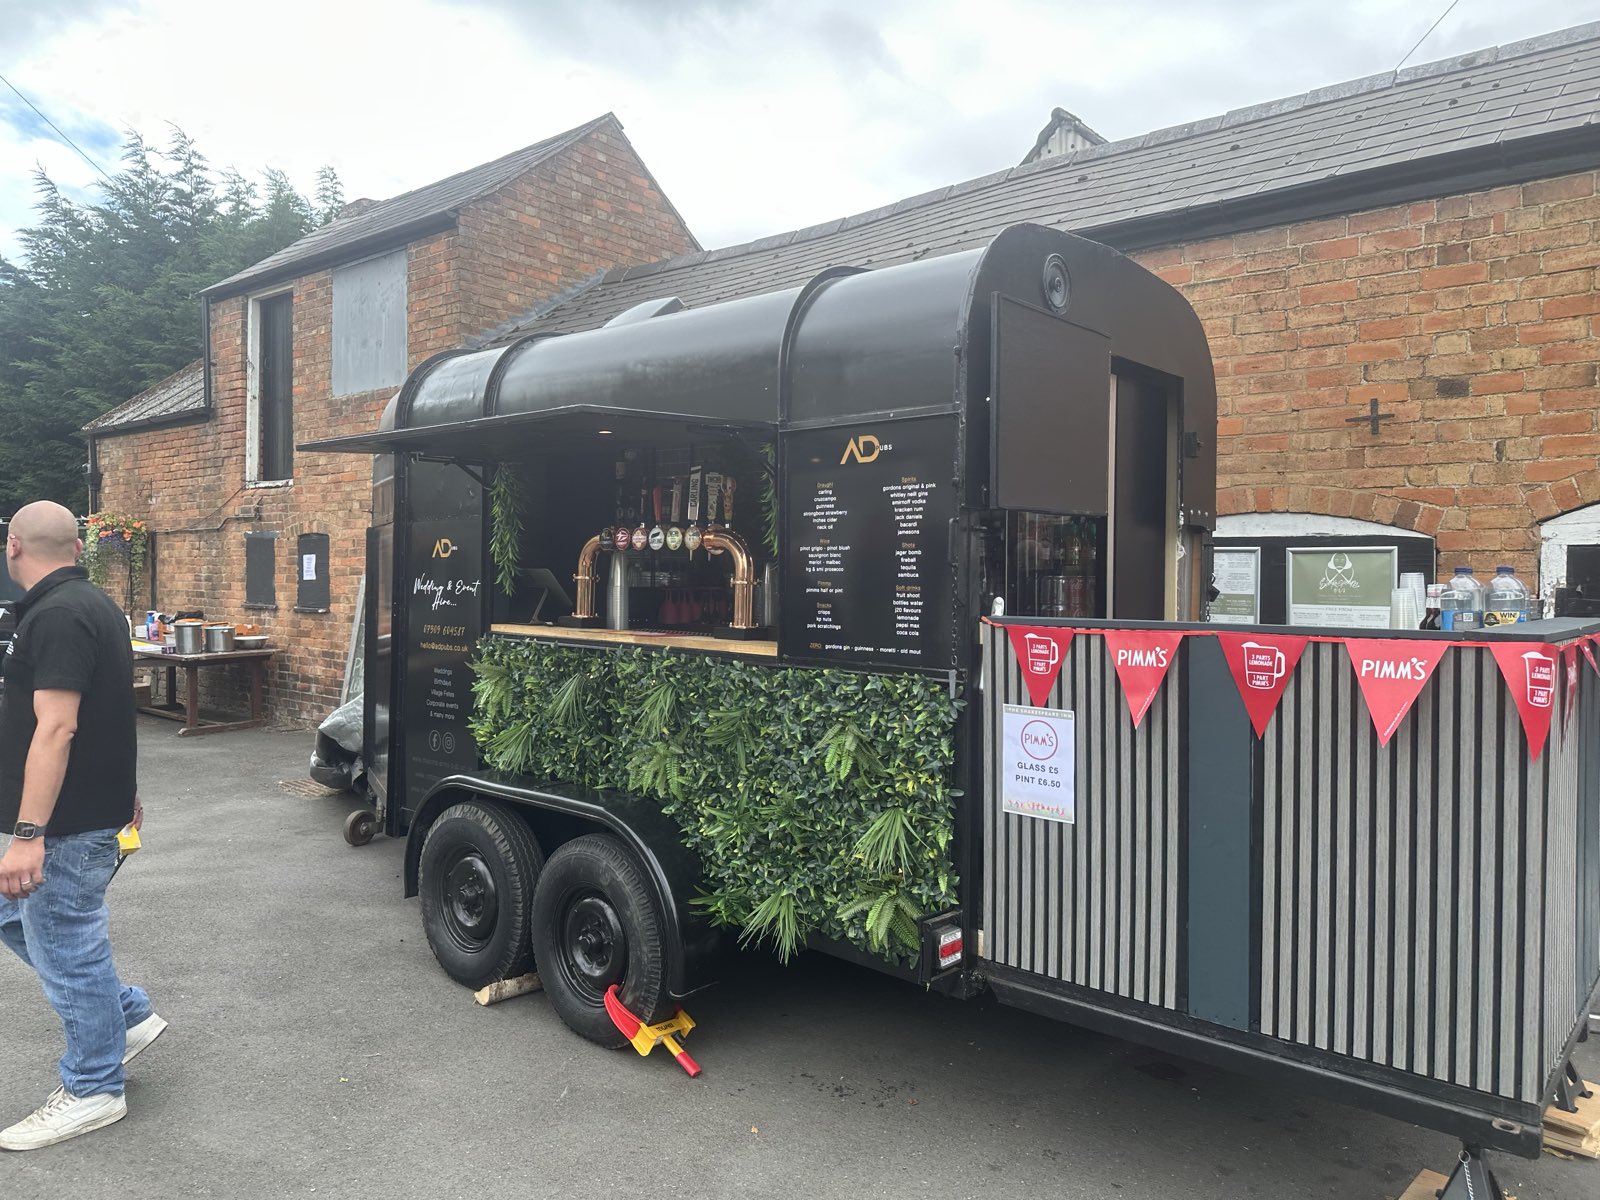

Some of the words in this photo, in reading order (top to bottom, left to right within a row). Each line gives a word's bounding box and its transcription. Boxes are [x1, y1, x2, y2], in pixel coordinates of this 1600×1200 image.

[840, 435, 880, 464] AD
[690, 478, 698, 506] CARLING
[432, 539, 451, 558] AD
[413, 572, 444, 596] Wedding
[447, 581, 453, 591] &
[455, 580, 481, 596] Event
[1118, 646, 1167, 667] PIMM'S
[1361, 657, 1426, 680] PIMM'S
[426, 699, 445, 707] Corporate
[1020, 709, 1059, 717] SHAKESPEARE
[1024, 733, 1054, 747] PIMM'S
[1017, 762, 1046, 772] GLASS
[1049, 766, 1059, 774] £5
[1015, 774, 1035, 784] PINT
[1038, 778, 1061, 788] £6.50
